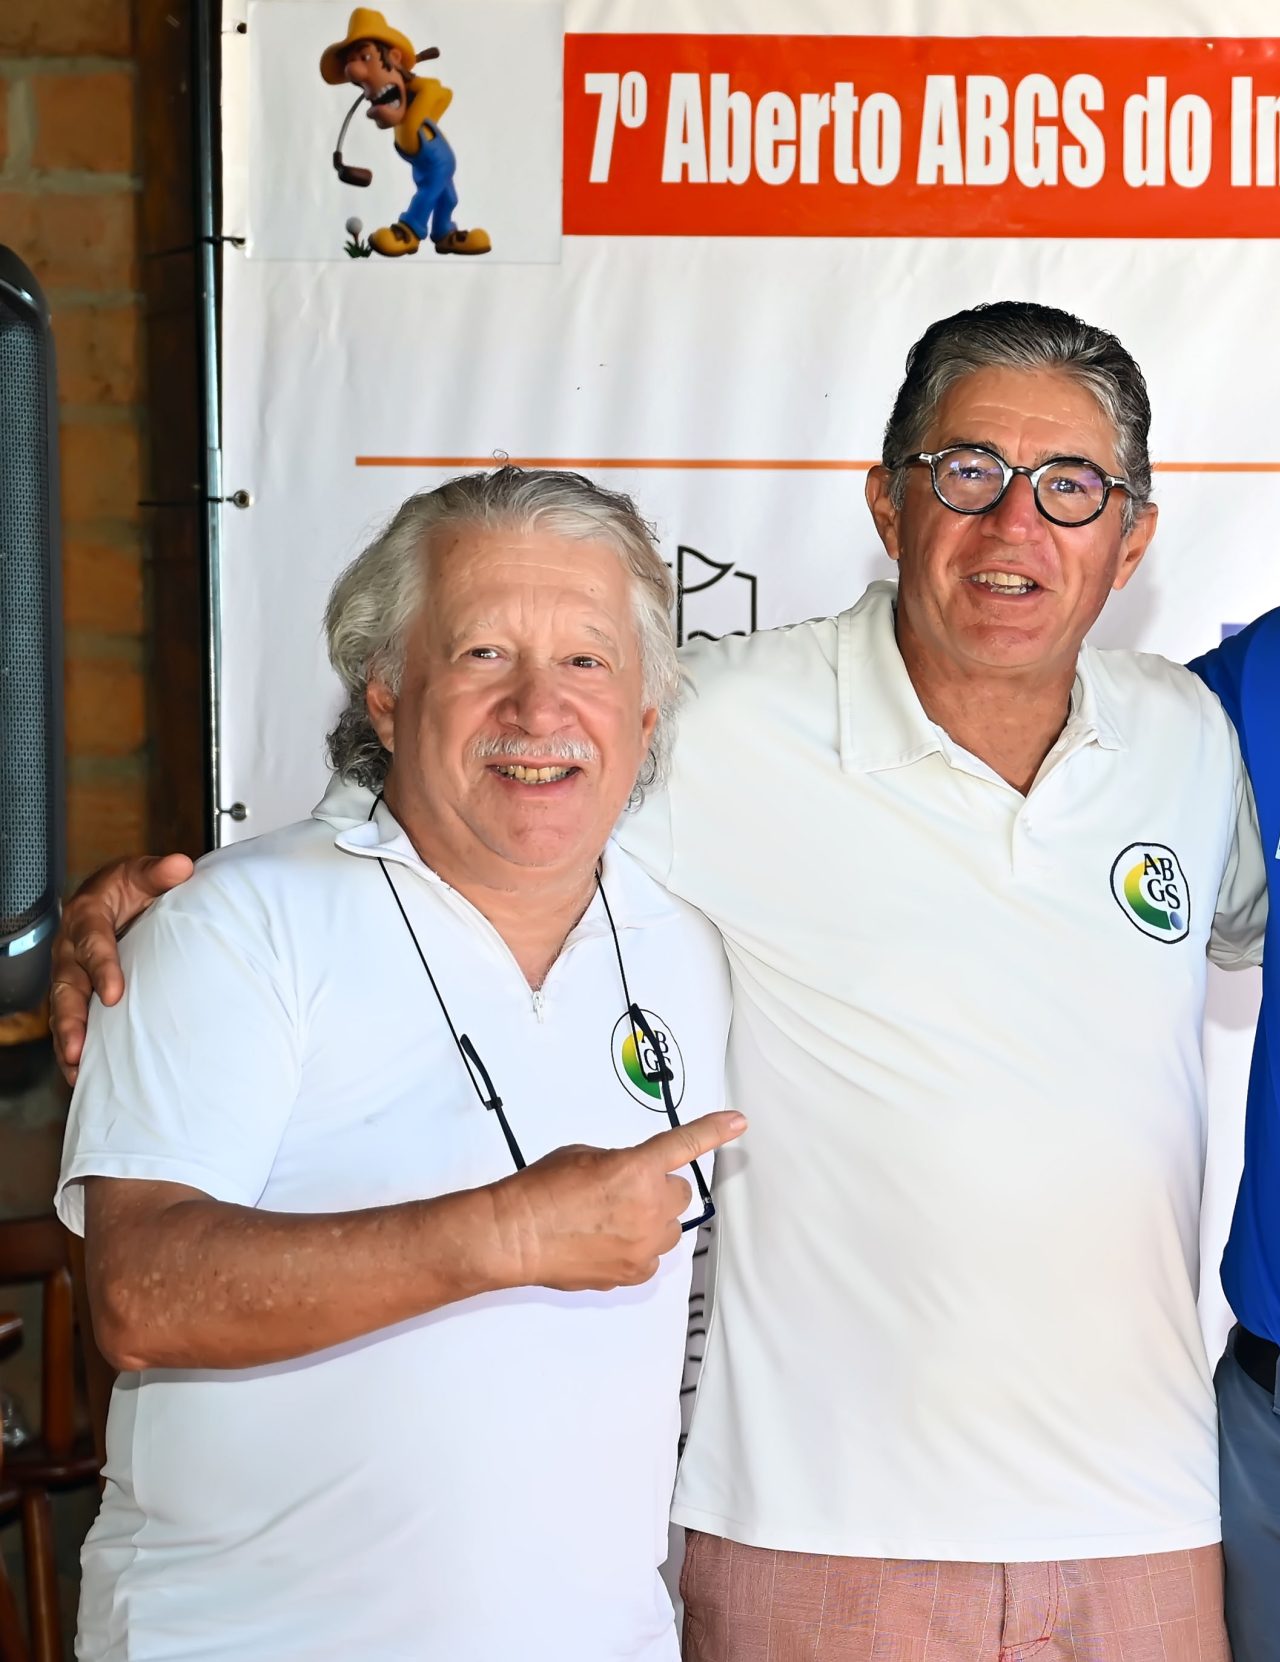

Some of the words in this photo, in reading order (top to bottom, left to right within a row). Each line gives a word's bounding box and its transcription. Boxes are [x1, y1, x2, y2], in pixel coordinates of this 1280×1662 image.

[584, 70, 648, 185] 7º
[660, 72, 902, 187] Aberto
[915, 73, 1106, 189] ABGS
[1122, 75, 1213, 189] do
